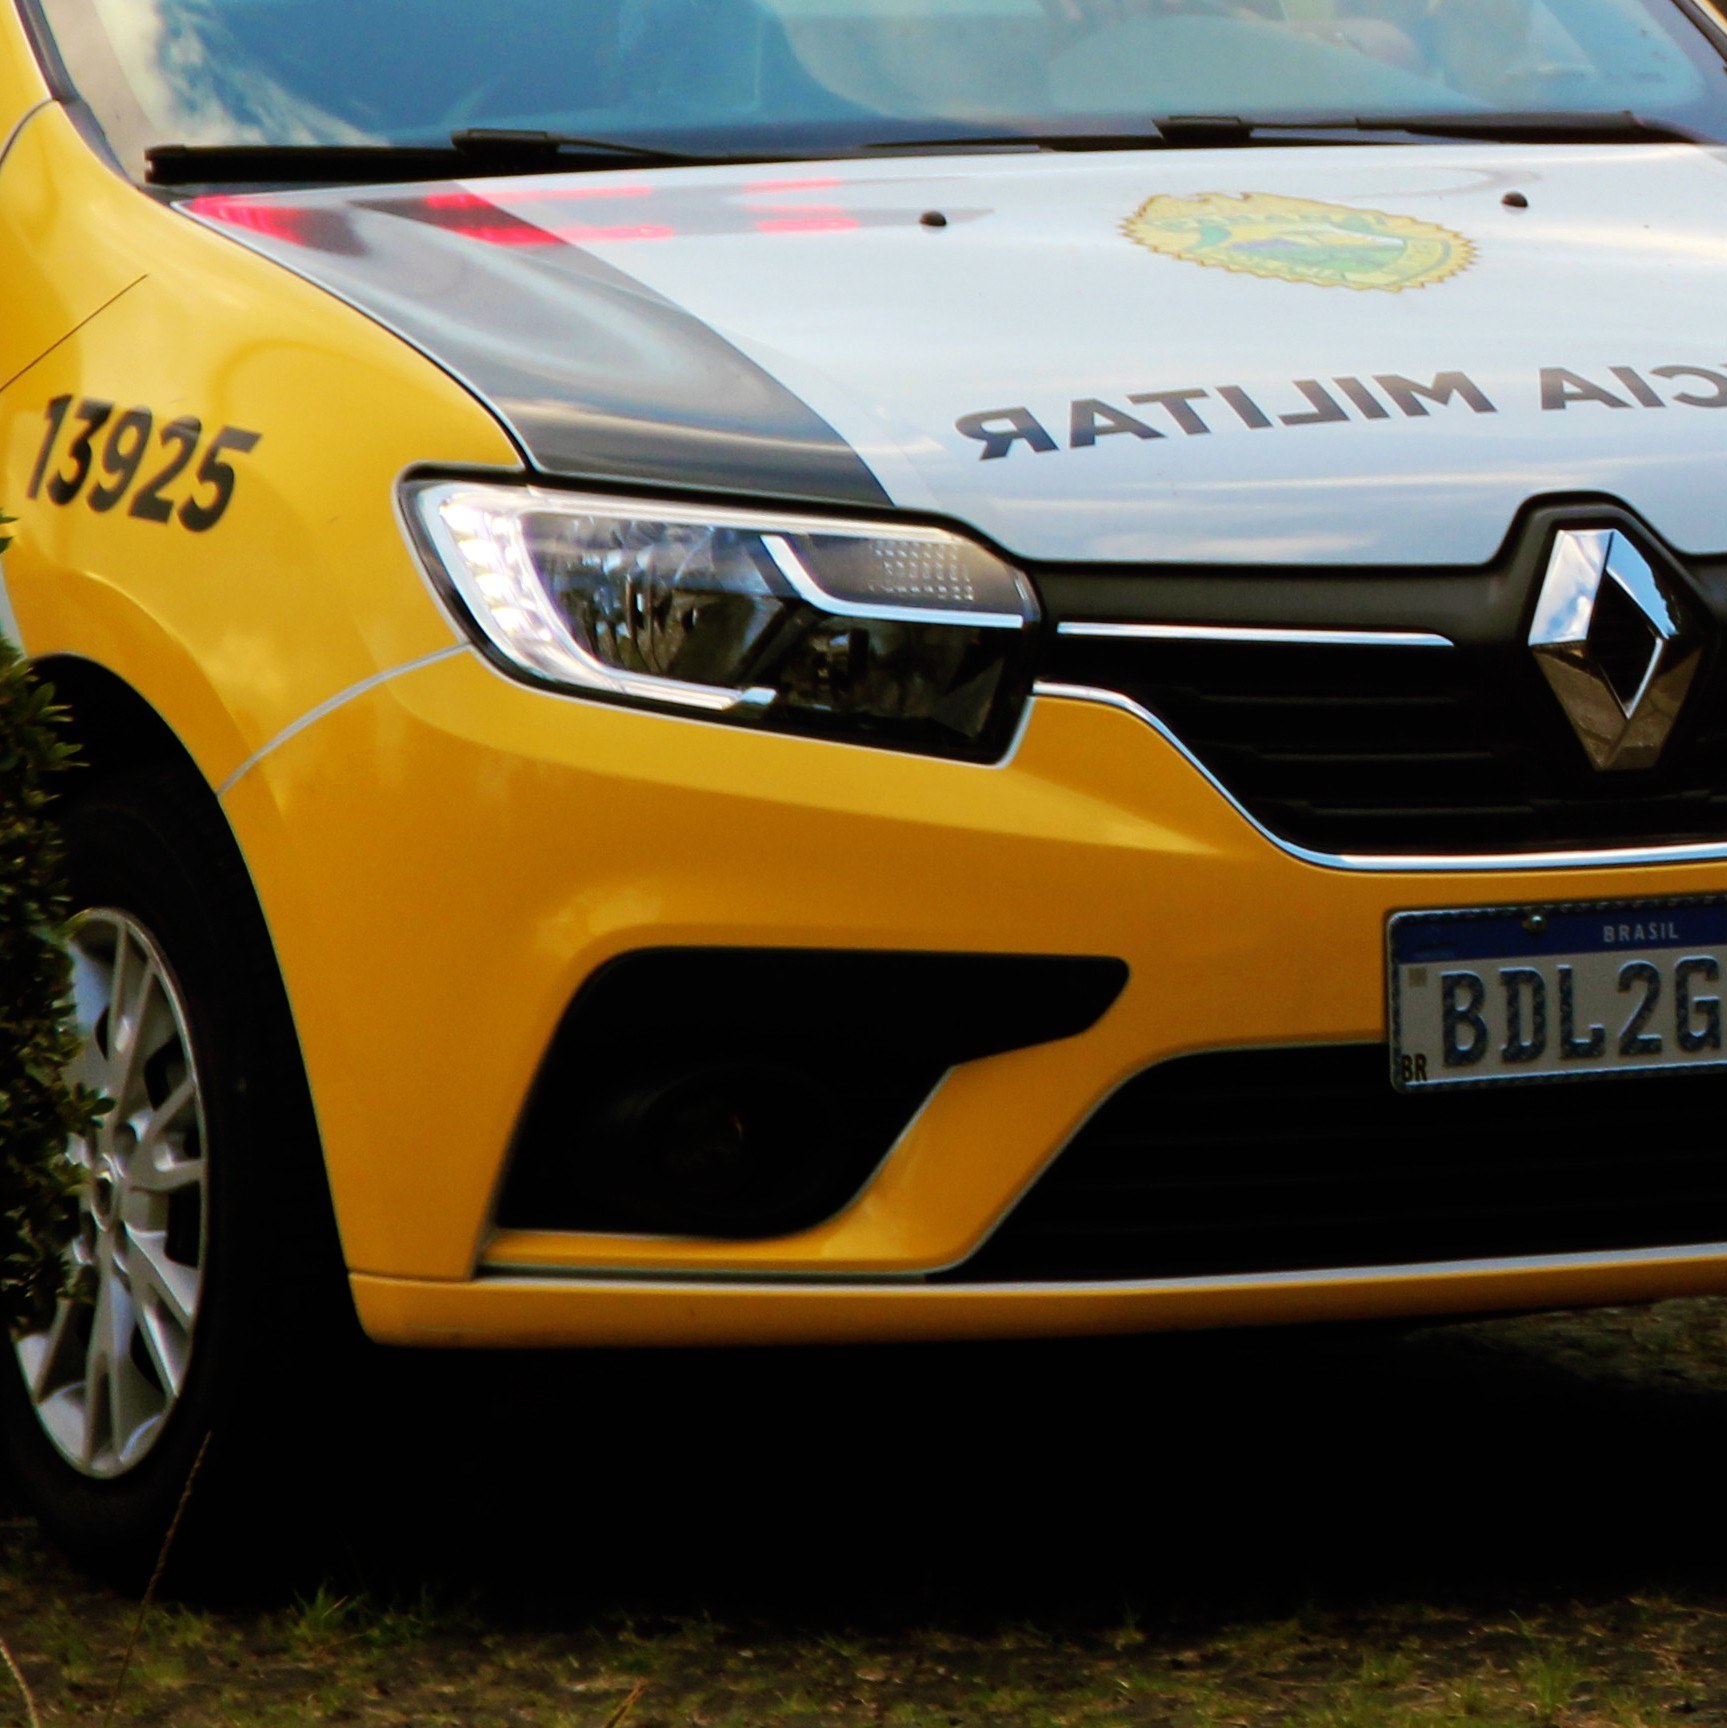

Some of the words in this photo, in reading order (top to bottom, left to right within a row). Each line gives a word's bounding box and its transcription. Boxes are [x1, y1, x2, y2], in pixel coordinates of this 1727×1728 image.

[26, 393, 263, 534] 13925
[1602, 921, 1680, 944] BRASIL
[1399, 1053, 1428, 1083] BR
